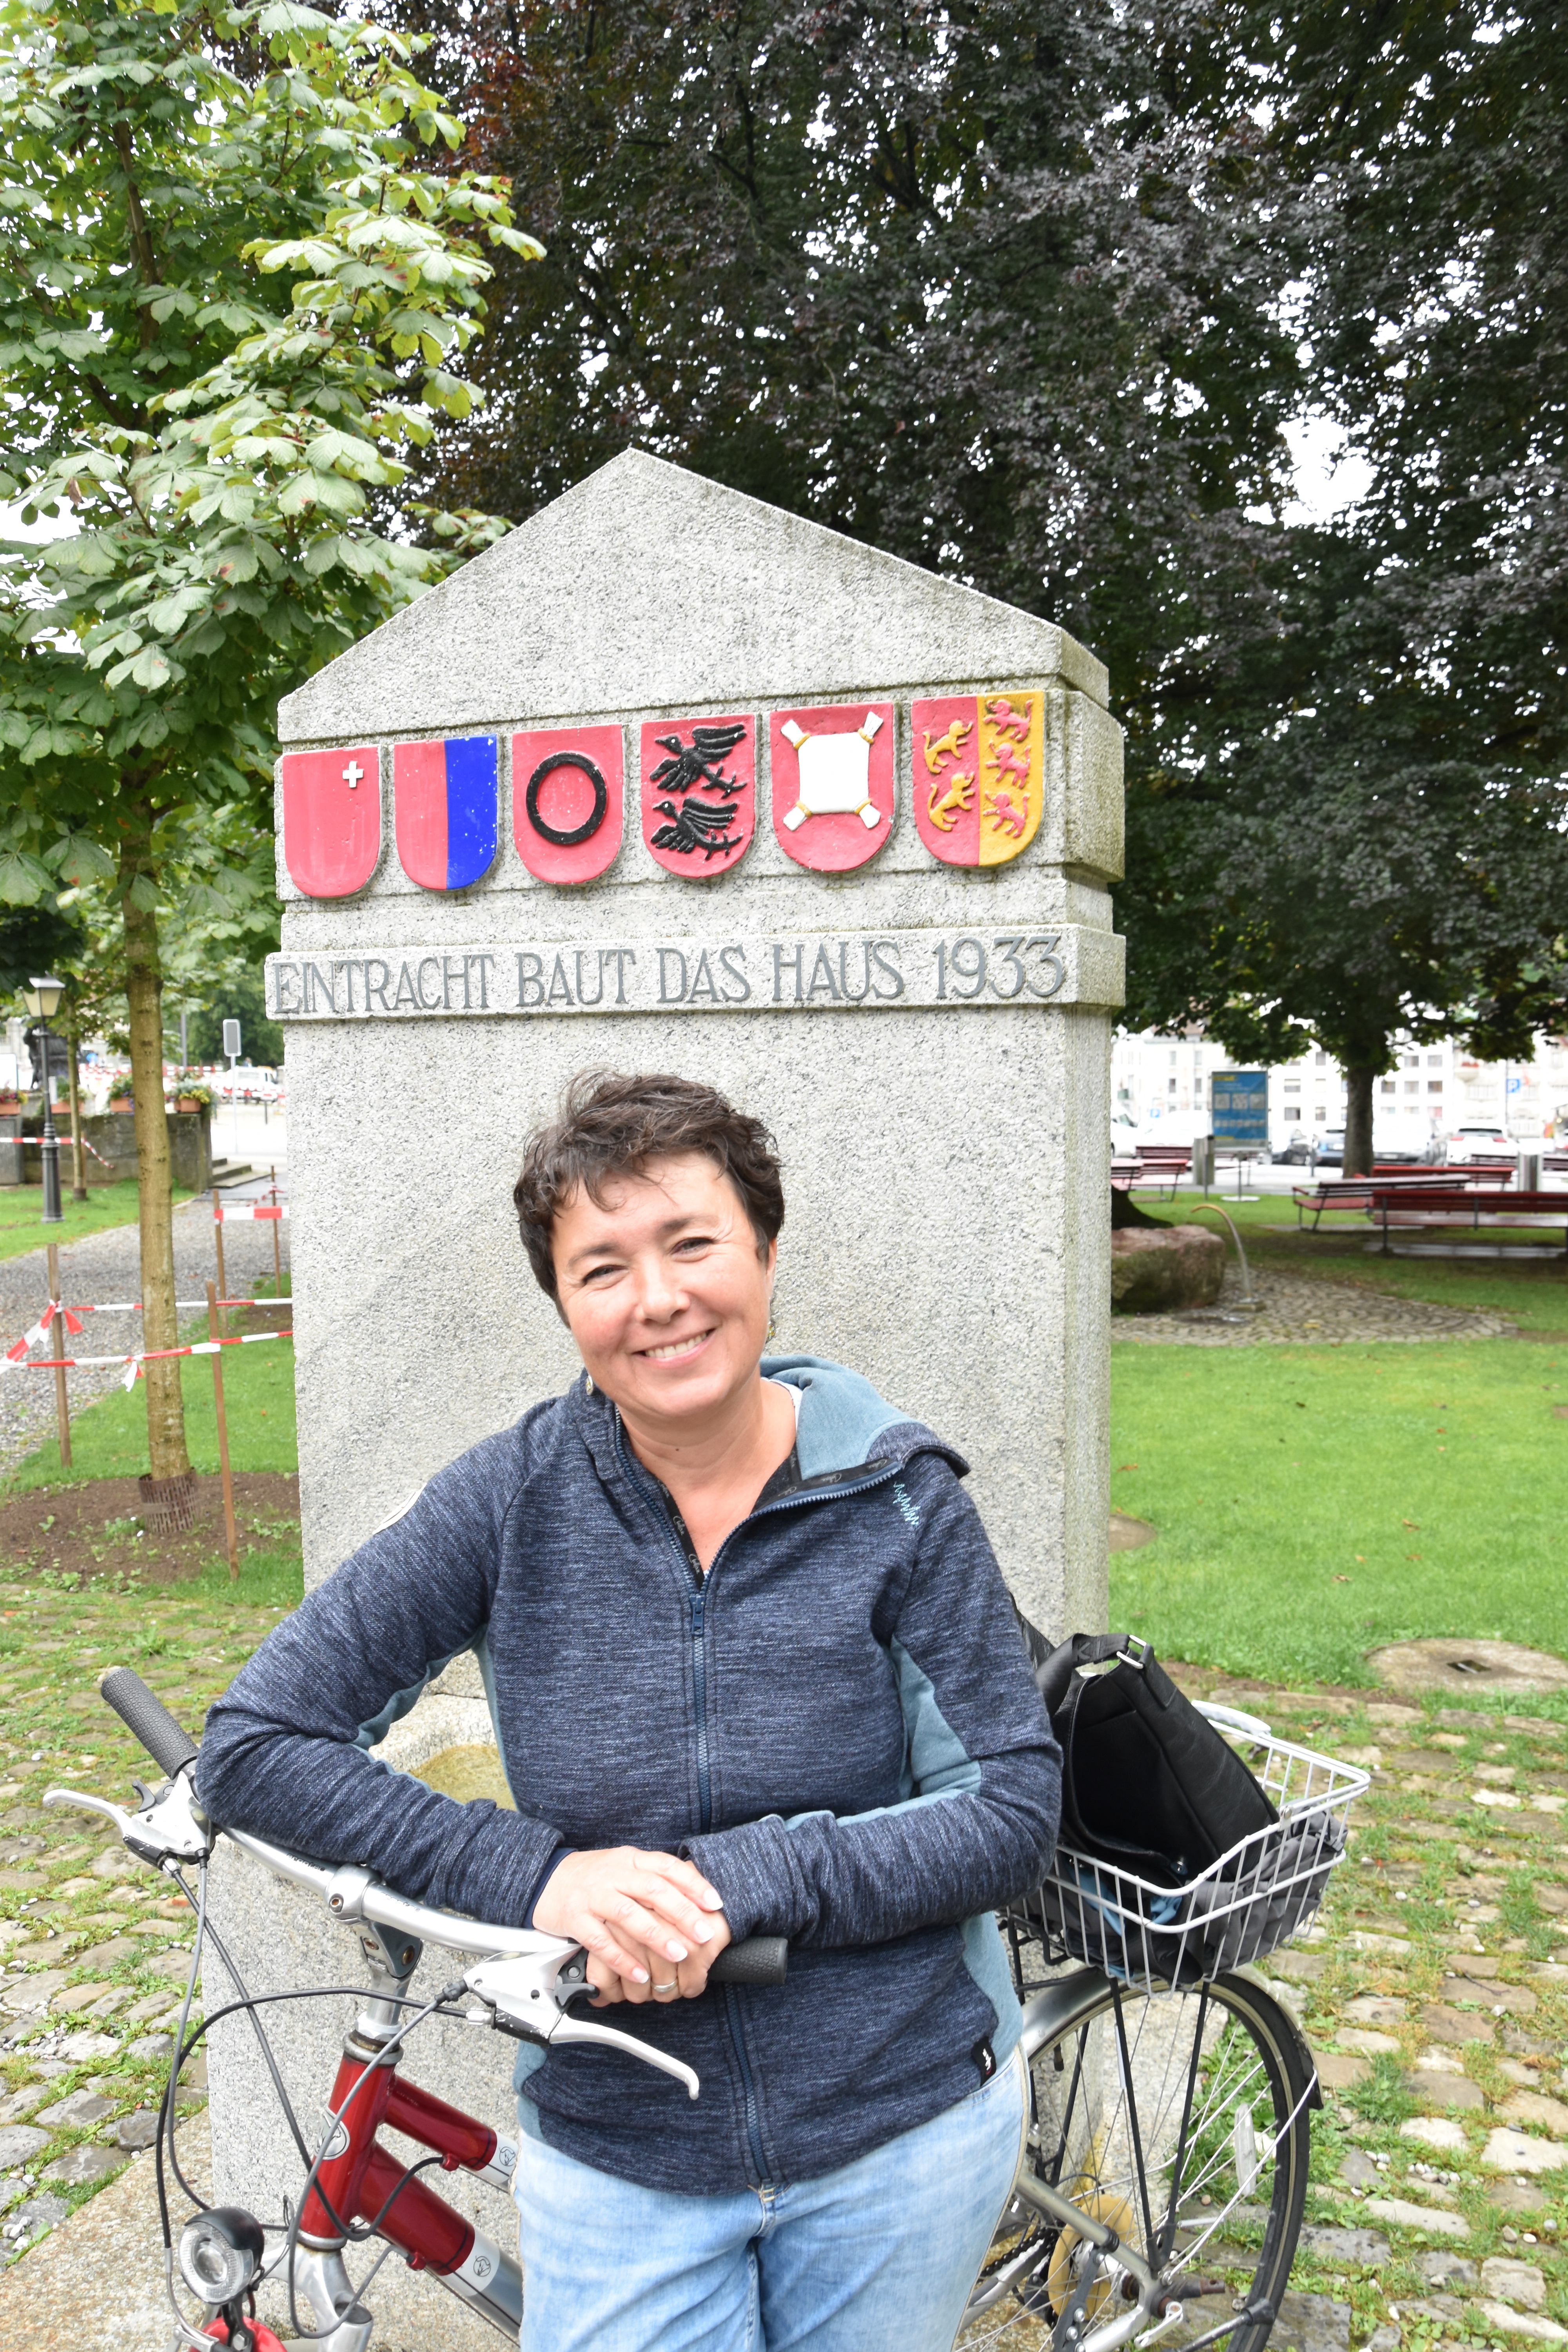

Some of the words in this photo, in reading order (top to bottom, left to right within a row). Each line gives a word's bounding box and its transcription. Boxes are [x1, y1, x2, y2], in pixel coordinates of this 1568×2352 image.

[272, 953, 495, 1013] EINTRACHT
[514, 948, 637, 1007] BAUT
[655, 943, 752, 1004] DAS
[772, 939, 905, 1001] HAUS
[933, 935, 1066, 998] 1933
